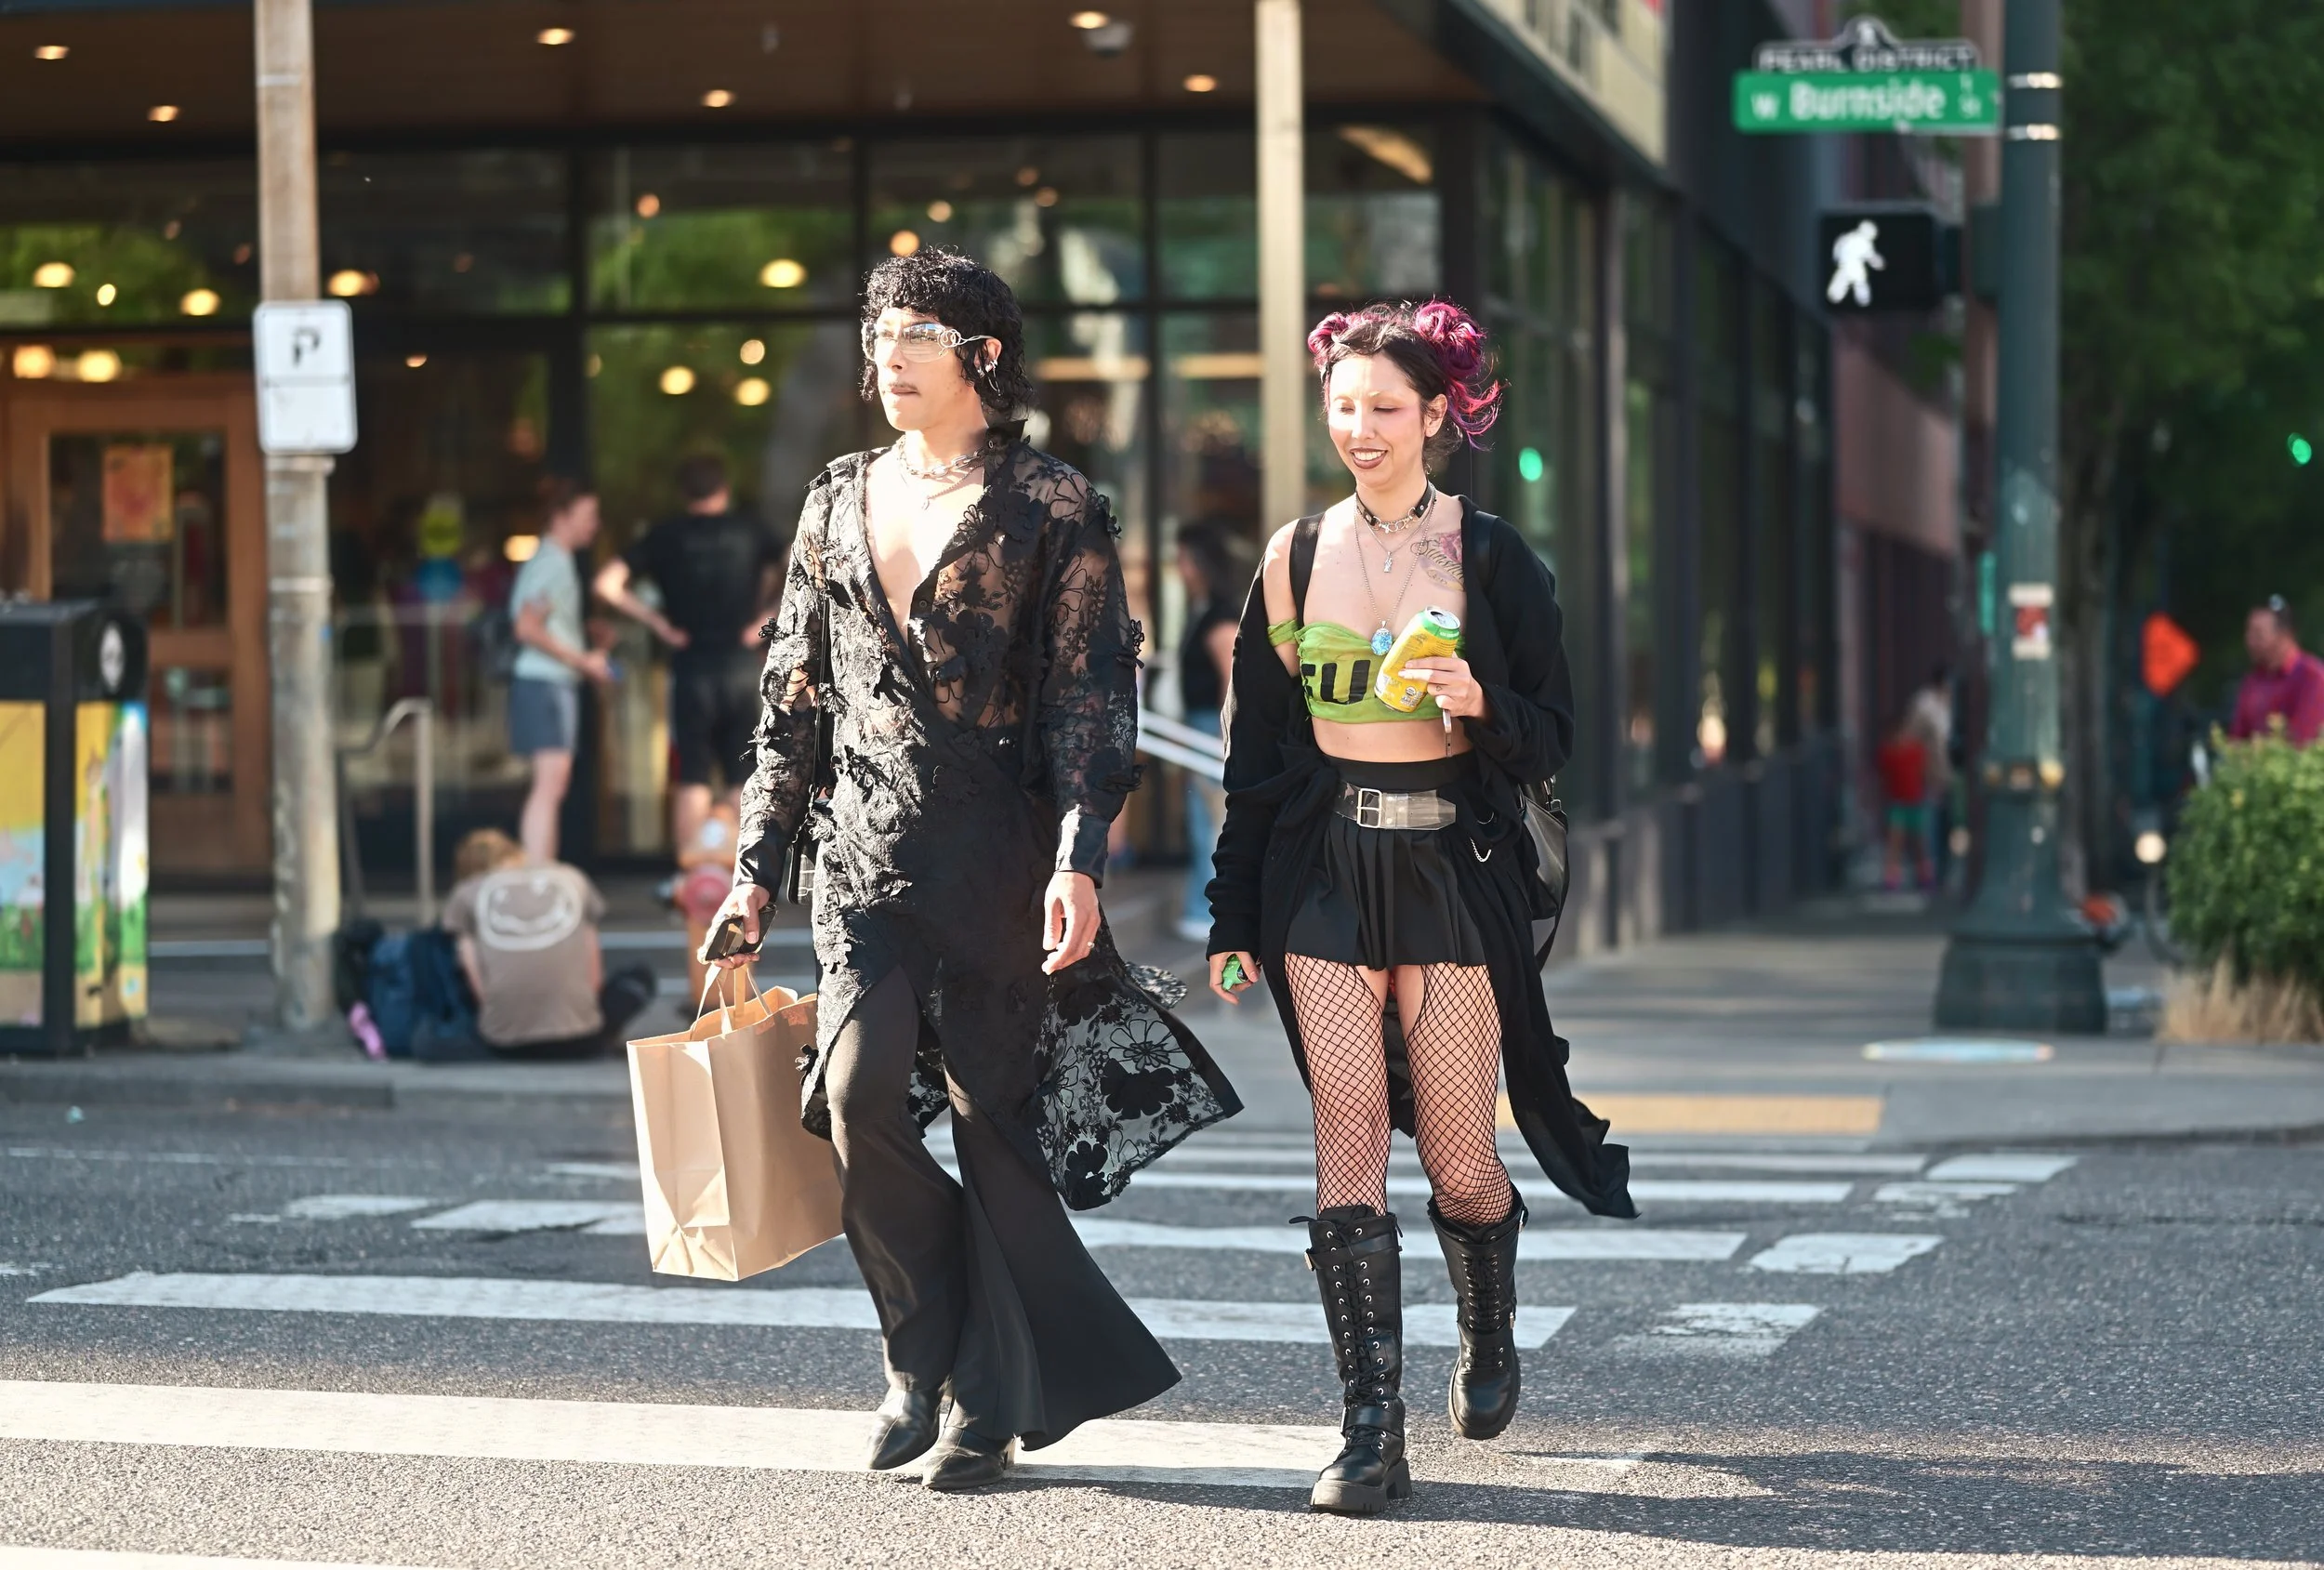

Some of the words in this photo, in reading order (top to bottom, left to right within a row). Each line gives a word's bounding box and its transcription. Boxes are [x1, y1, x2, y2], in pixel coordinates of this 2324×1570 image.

[1759, 48, 1847, 73] PEARL
[1852, 46, 1974, 73] DISTRICT
[1789, 78, 1946, 121] Burnside
[292, 326, 322, 368] P
